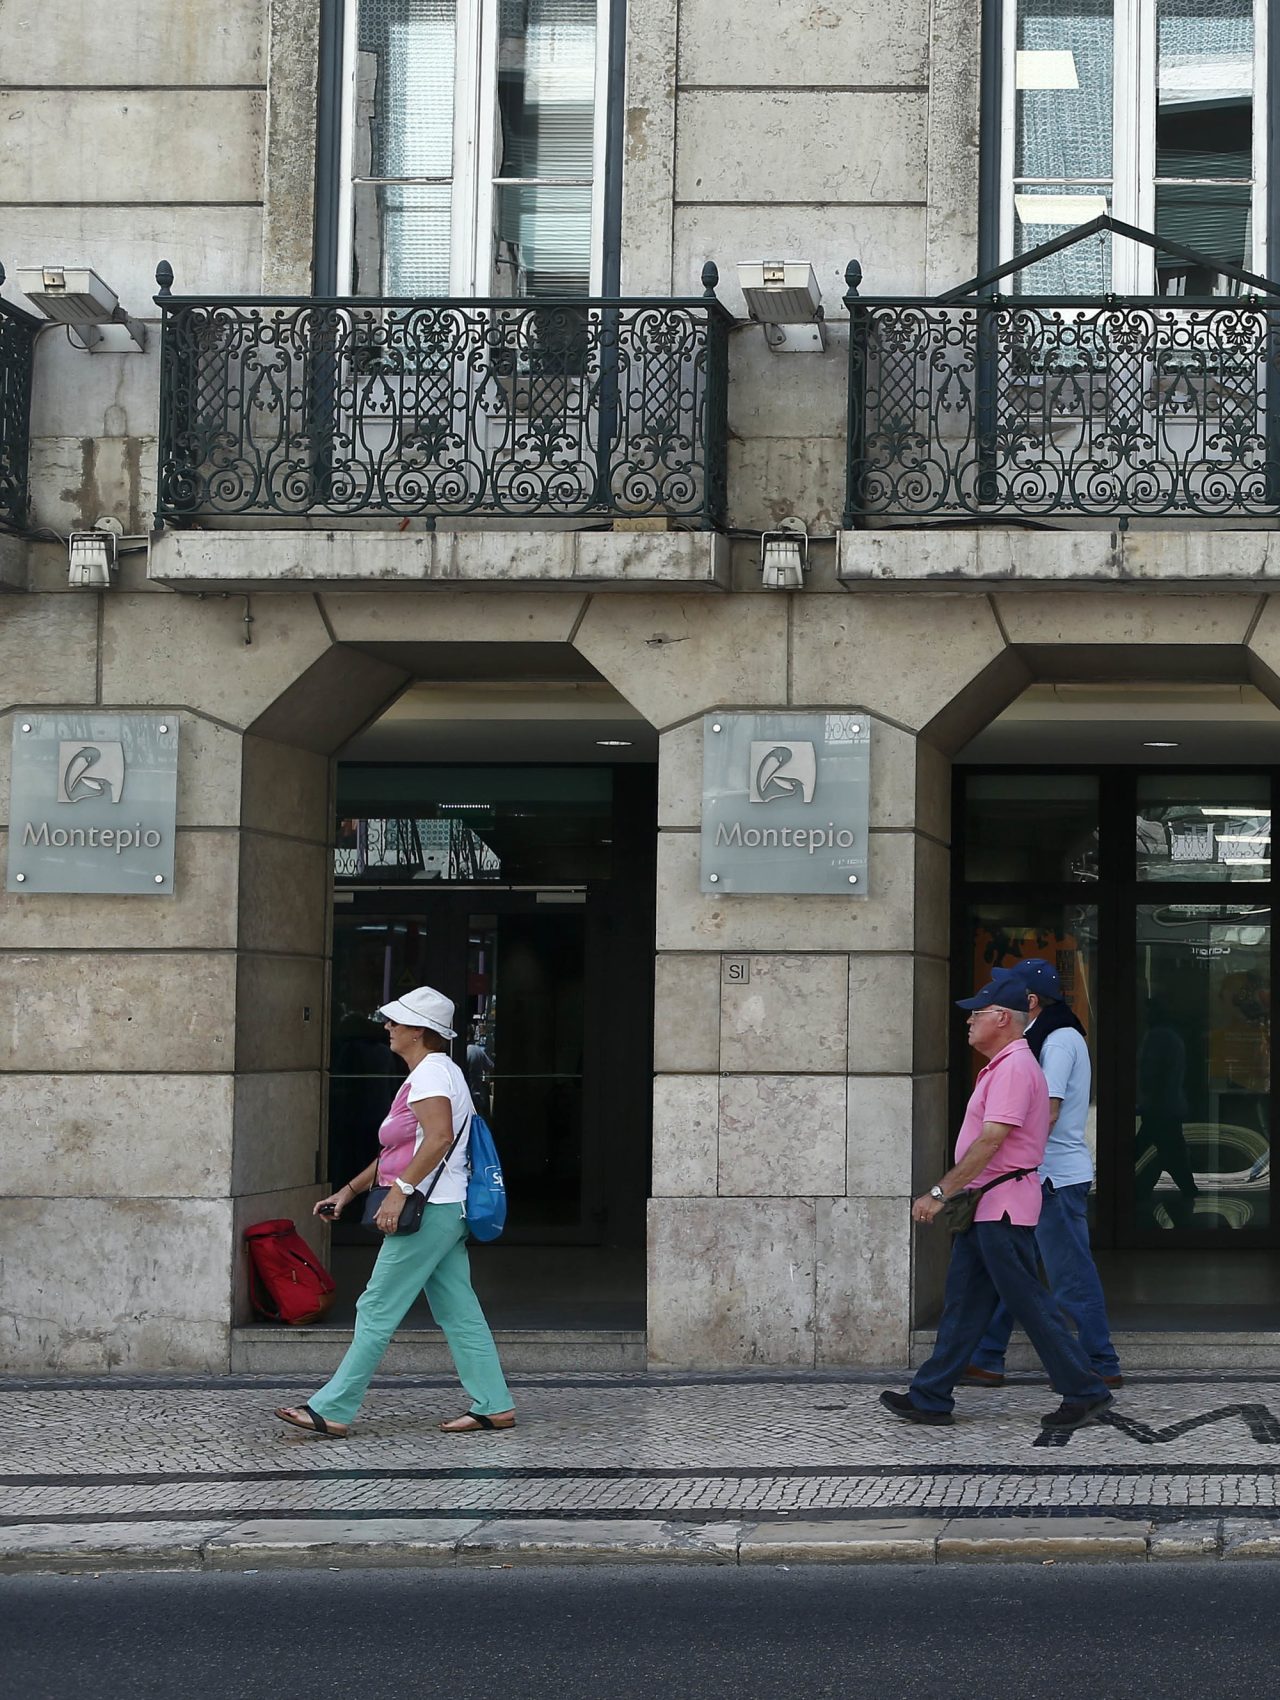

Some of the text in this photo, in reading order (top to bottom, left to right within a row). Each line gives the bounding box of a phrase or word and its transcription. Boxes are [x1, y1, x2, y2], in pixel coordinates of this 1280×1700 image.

[22, 821, 162, 854] Montepio
[714, 821, 854, 854] Montepio
[729, 964, 744, 979] SI
